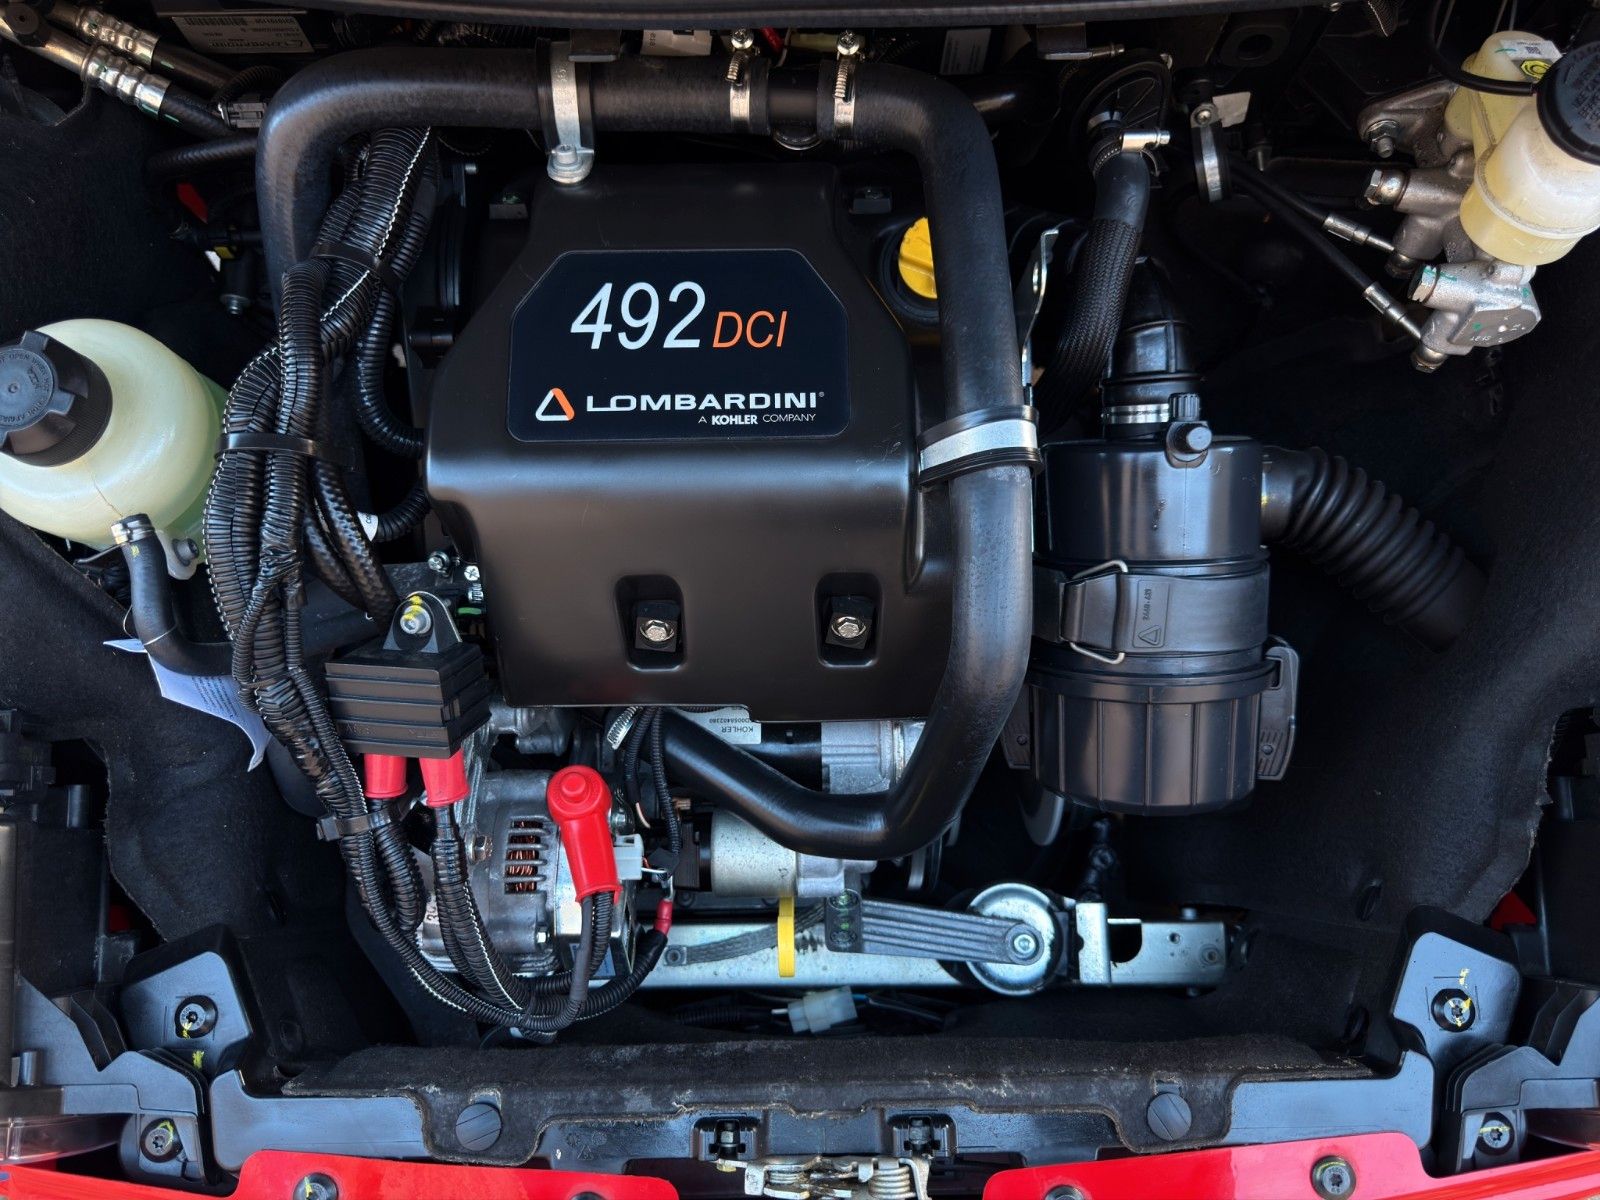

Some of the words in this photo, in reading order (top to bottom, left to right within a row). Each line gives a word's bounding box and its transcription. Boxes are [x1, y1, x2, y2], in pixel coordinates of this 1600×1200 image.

[570, 281, 706, 350] 492
[712, 310, 788, 349] DCI
[698, 416, 708, 424] A
[711, 414, 758, 425] KOHLER
[762, 413, 816, 423] COMPANY
